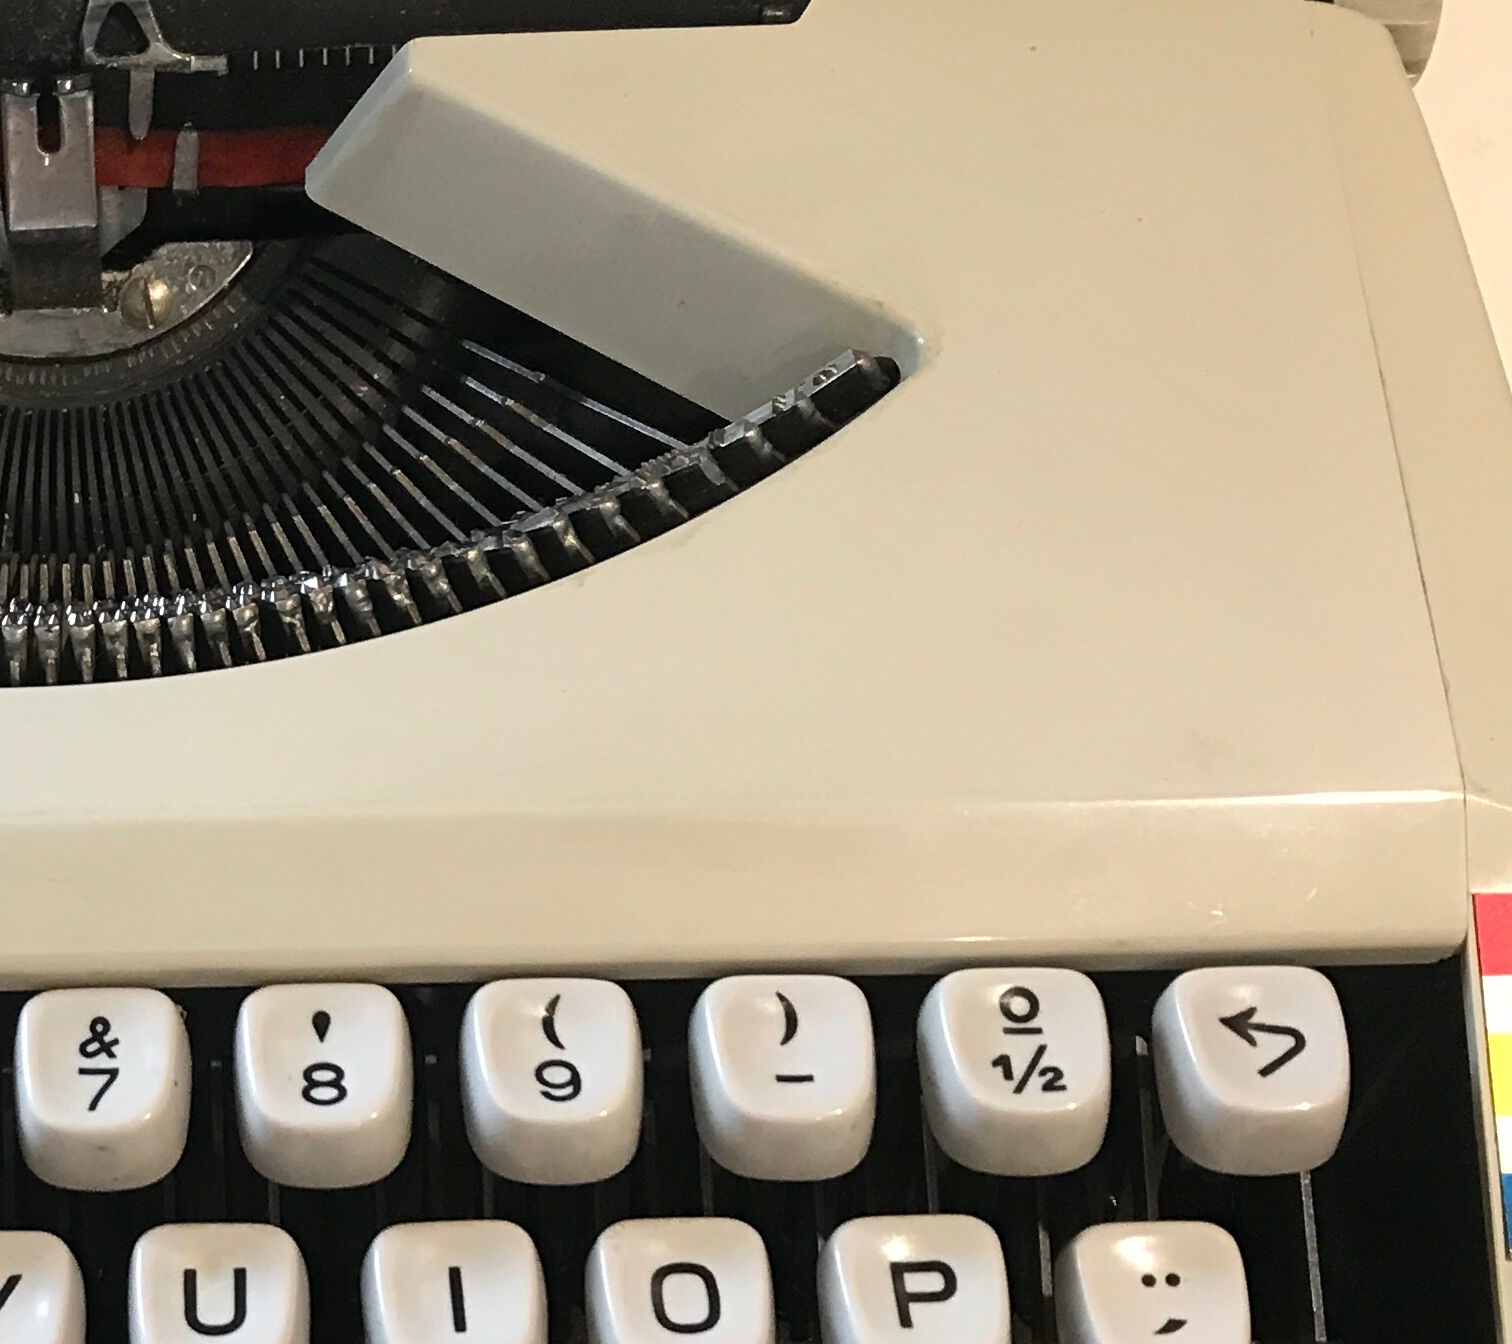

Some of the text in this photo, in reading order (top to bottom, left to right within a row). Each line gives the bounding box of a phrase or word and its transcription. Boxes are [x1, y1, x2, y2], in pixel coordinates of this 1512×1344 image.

[78, 1015, 120, 1059] &
[77, 1067, 120, 1112] 7
[301, 1062, 348, 1106] 8
[534, 1059, 582, 1102] 9
[183, 1267, 247, 1337] U
[448, 1266, 467, 1333] I
[650, 1262, 721, 1335] O
[889, 1260, 958, 1329] P
